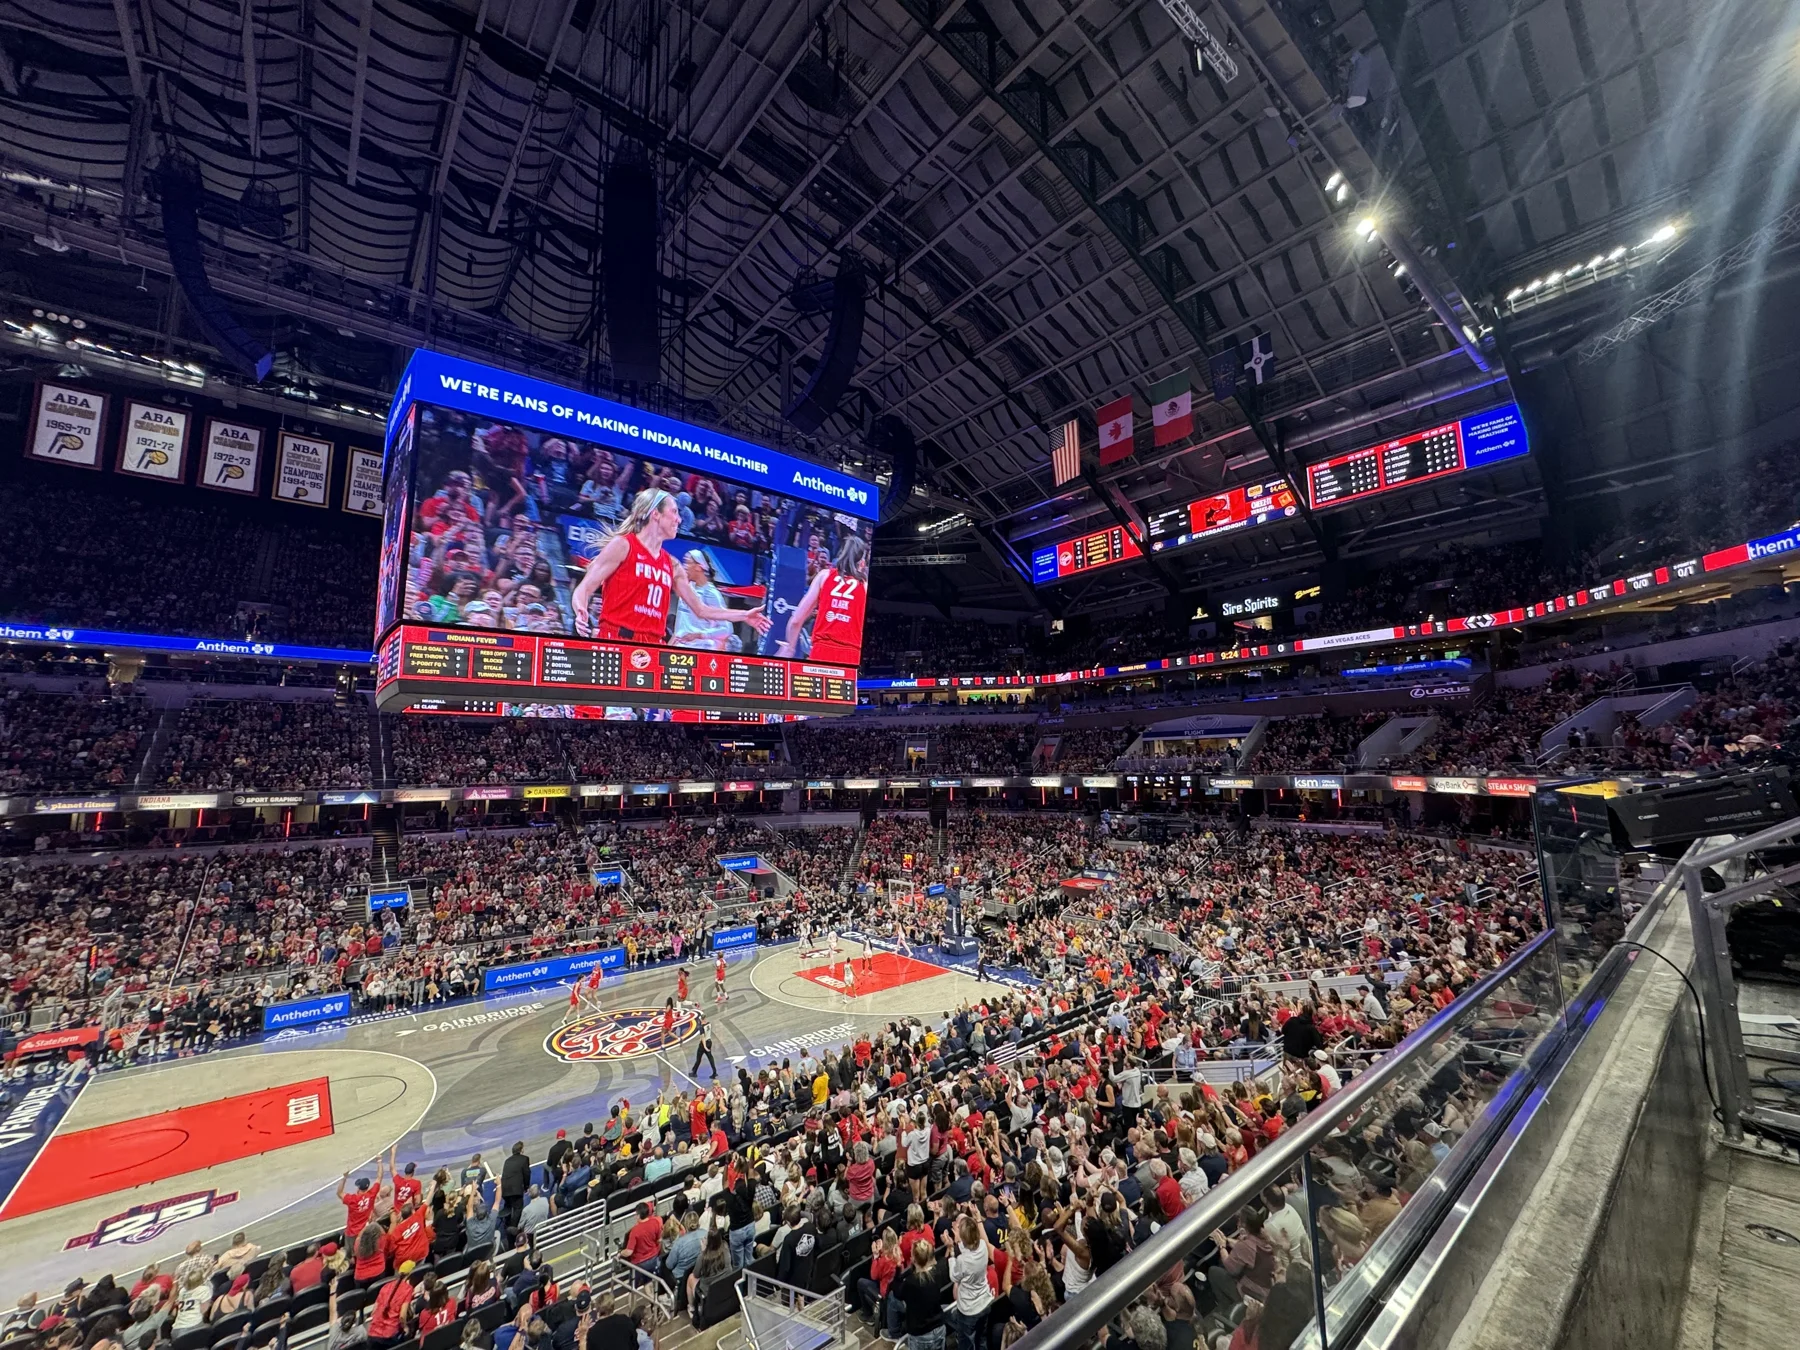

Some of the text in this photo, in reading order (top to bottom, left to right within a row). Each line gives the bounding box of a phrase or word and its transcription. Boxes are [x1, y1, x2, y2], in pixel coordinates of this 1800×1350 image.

[53, 392, 91, 409] ABA
[141, 411, 175, 426] ABA
[439, 374, 769, 475] WE'RE FANS OF MAKING INDIANA HEALTHIER
[1489, 418, 1504, 426] FANS
[46, 419, 91, 436] 1969-70
[1468, 420, 1518, 437] MAKING INDIANA
[1478, 427, 1509, 440] HEALTHIER
[220, 427, 250, 441] ABA
[136, 437, 175, 451] 1971-72
[292, 442, 319, 456] NBA
[1475, 444, 1503, 456] Anthem
[212, 451, 251, 466] 1972-73
[283, 465, 324, 481] CHAMPIONS
[791, 471, 845, 499] Anthem
[352, 489, 382, 501] 1998-9
[830, 575, 858, 600] 22
[647, 583, 663, 608] 10
[1222, 596, 1279, 617] Sire Spirits
[447, 634, 497, 645] INDIANA FEVER
[1323, 633, 1371, 645] LAS VEGAS ACES
[195, 641, 249, 653] Anthem
[1277, 644, 1285, 653] 0
[669, 654, 694, 666] 9:24
[1220, 650, 1239, 661] 9:24
[636, 674, 645, 686] 5
[709, 679, 717, 690] 0
[891, 680, 917, 688] Anthem
[1425, 685, 1471, 695] LEXUS
[1294, 777, 1319, 787] ksm
[1435, 781, 1461, 790] KeyBank
[1488, 782, 1508, 790] STEAK
[533, 787, 569, 796] GAINBRIDGE
[50, 800, 117, 811] planet fitness
[270, 796, 302, 804] GRAPHICS
[1719, 812, 1752, 821] DIGISUPER
[716, 935, 742, 945] Anthem
[495, 971, 532, 983] Anthem
[271, 1007, 321, 1024] Anthem
[422, 1002, 545, 1032] GAINBRIDGE
[35, 1034, 79, 1047] State Farm
[749, 1022, 857, 1057] GAINBRIDGE
[771, 1029, 855, 1059] FIELDHOUSE
[753, 1124, 762, 1133] 22
[400, 1186, 411, 1197] 22
[98, 1194, 209, 1246] 25
[402, 1222, 420, 1240] 22
[434, 1310, 449, 1326] 17
